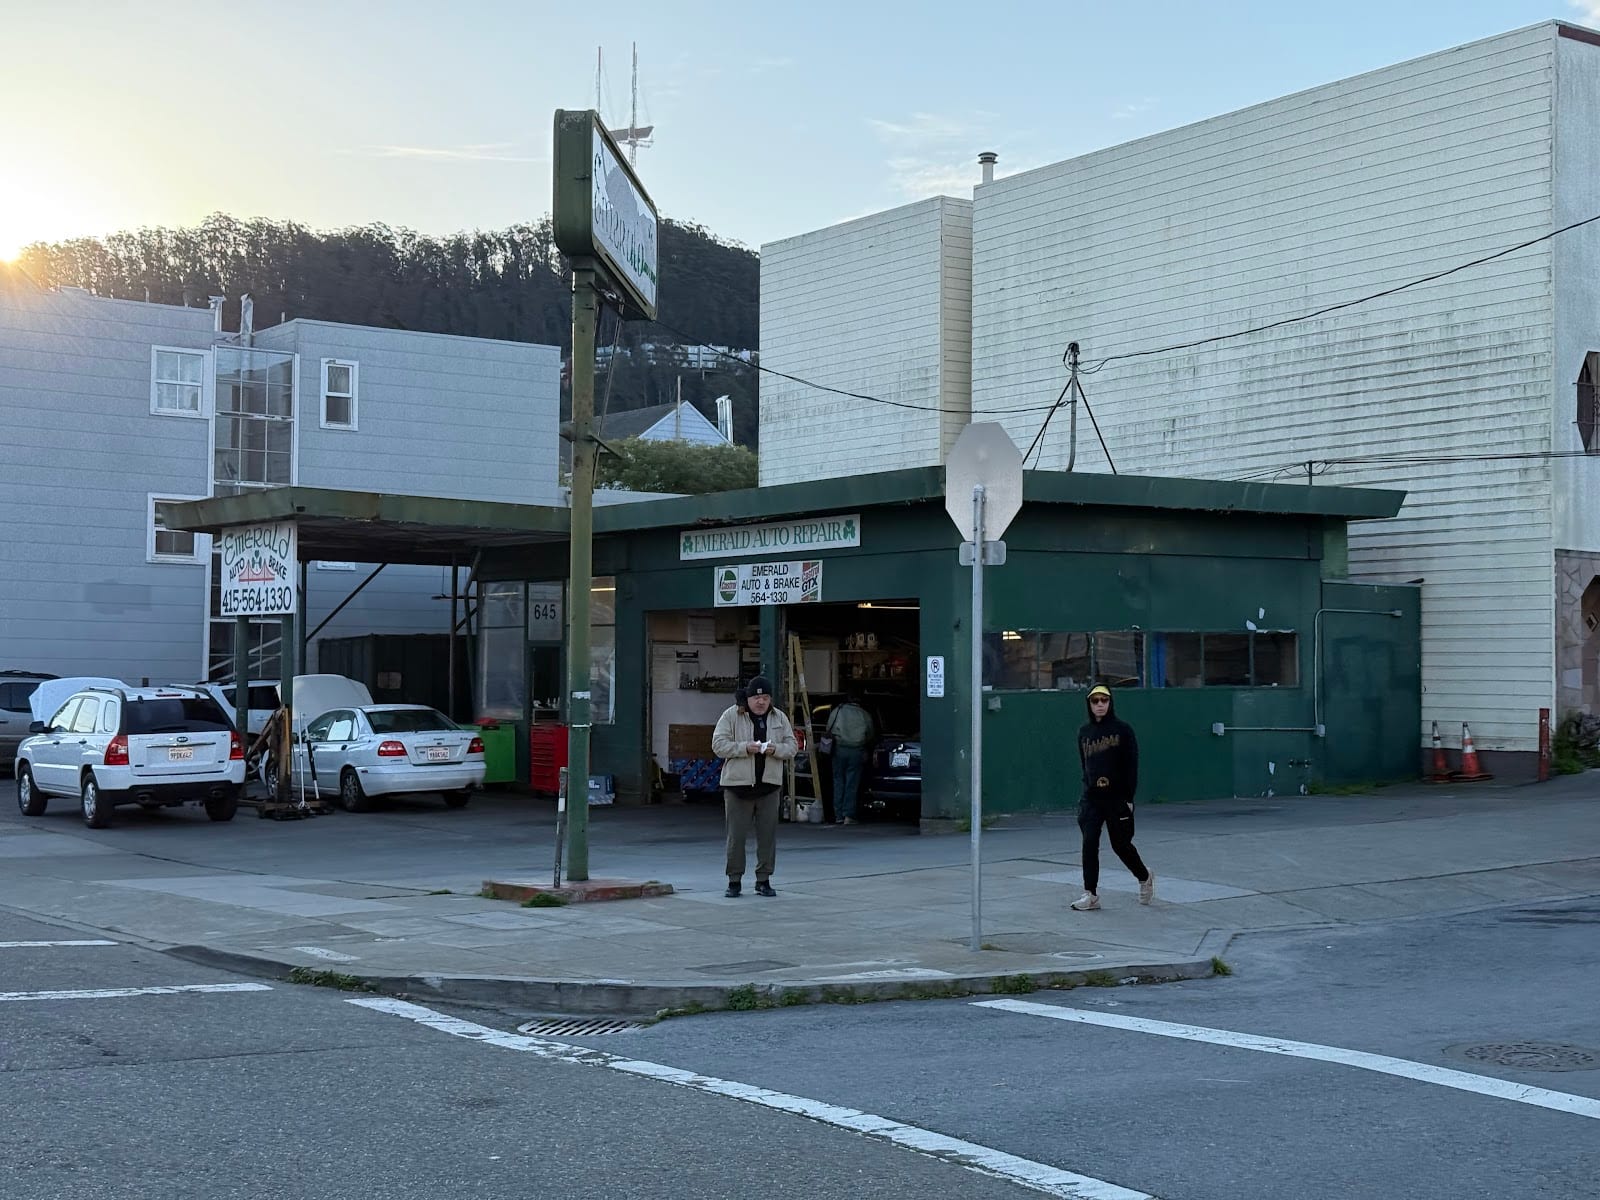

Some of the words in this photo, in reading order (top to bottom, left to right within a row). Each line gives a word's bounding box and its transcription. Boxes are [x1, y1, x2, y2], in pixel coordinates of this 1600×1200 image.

[694, 531, 750, 553] EMERALD
[752, 526, 790, 548] AUTO
[792, 521, 843, 544] REPAIR
[229, 557, 245, 582] AUTO
[268, 555, 288, 581] BRAKE
[752, 564, 789, 577] EMERALD
[741, 579, 761, 590] AUTO
[764, 579, 770, 590] &
[773, 577, 800, 589] BRAKE
[801, 575, 818, 593] GTX
[750, 591, 788, 604] 564-1330
[534, 604, 556, 620] 645
